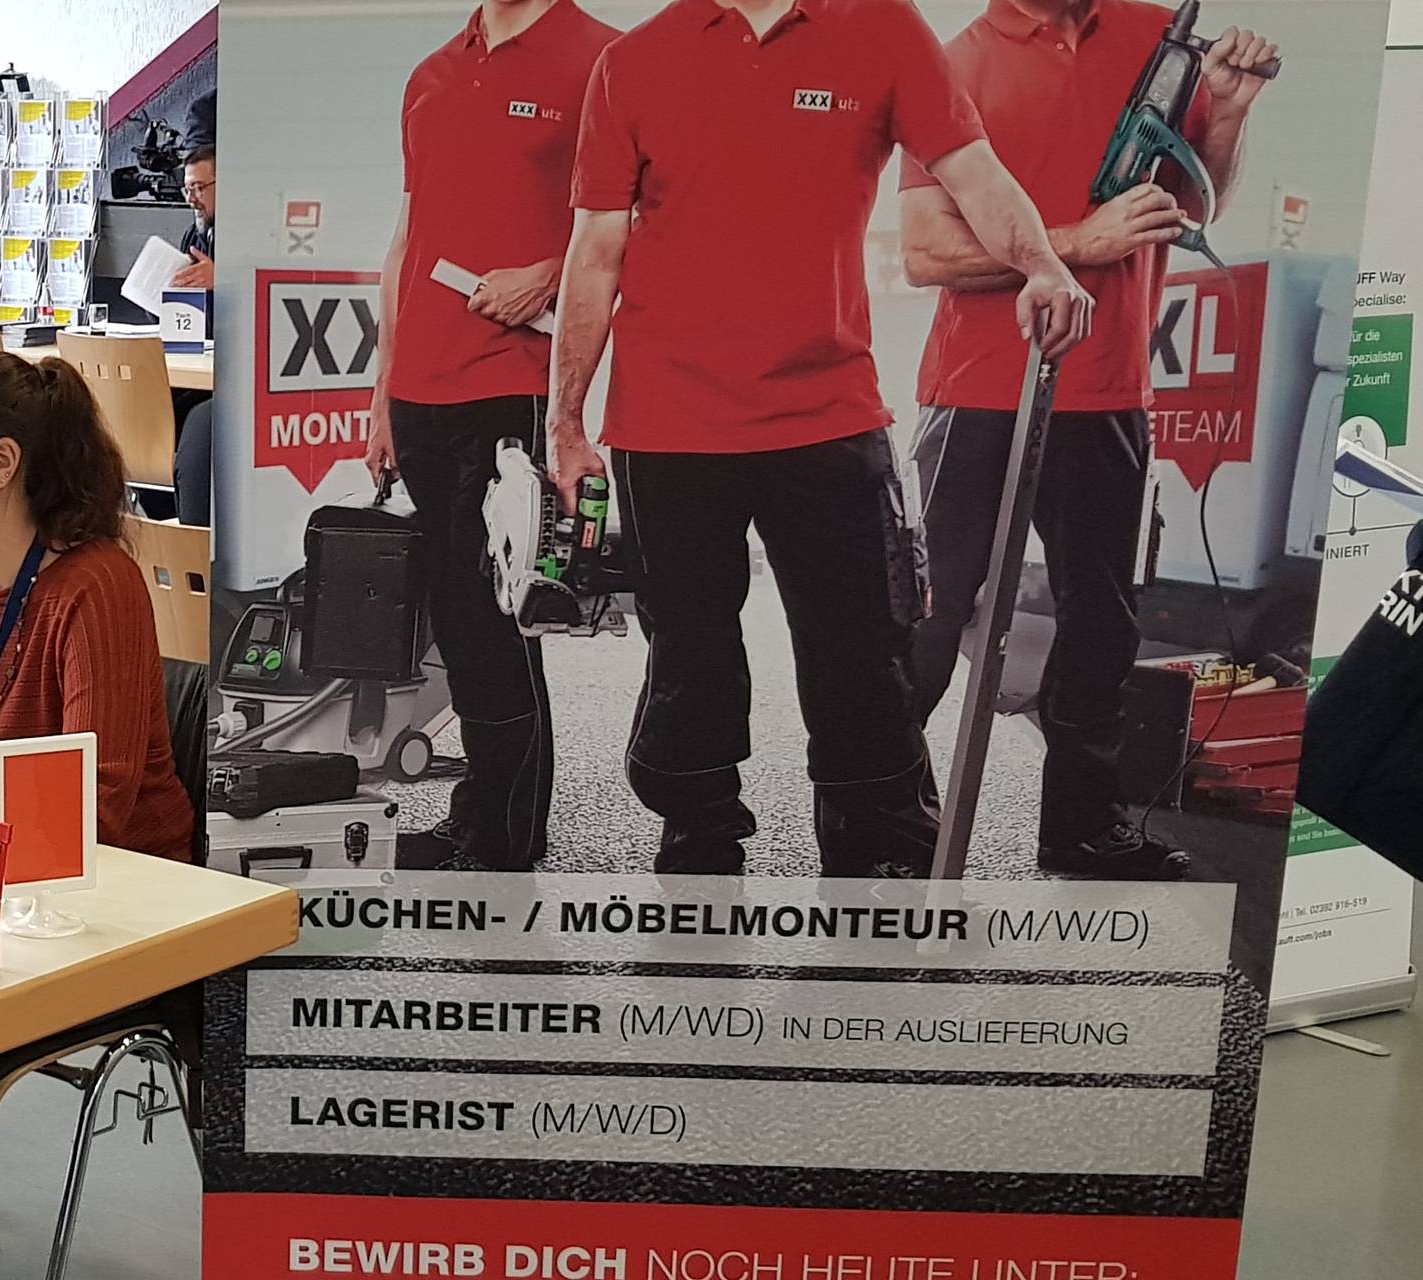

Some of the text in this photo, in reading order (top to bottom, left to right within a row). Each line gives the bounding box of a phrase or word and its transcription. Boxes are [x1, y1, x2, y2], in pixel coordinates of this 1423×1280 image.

[1379, 271, 1406, 285] Way
[176, 318, 192, 330] 12
[1365, 329, 1381, 342] die
[1352, 372, 1391, 387] Zukunft
[1326, 544, 1370, 561] INIERT
[298, 890, 506, 931] KÜCHEN-
[560, 895, 969, 941] MÖBELMONTEUR
[987, 908, 1150, 950] (M/W/D)
[291, 997, 1129, 1046] MITARBEITER (M/WD) IN DER AUSLIEFERUNG
[290, 1095, 687, 1143] LAGERIST (M/W/D)
[288, 1238, 485, 1275] BEWIRB
[505, 1243, 627, 1280] DICH
[646, 1248, 783, 1280] NOCH
[802, 1253, 955, 1280] HEUTE
